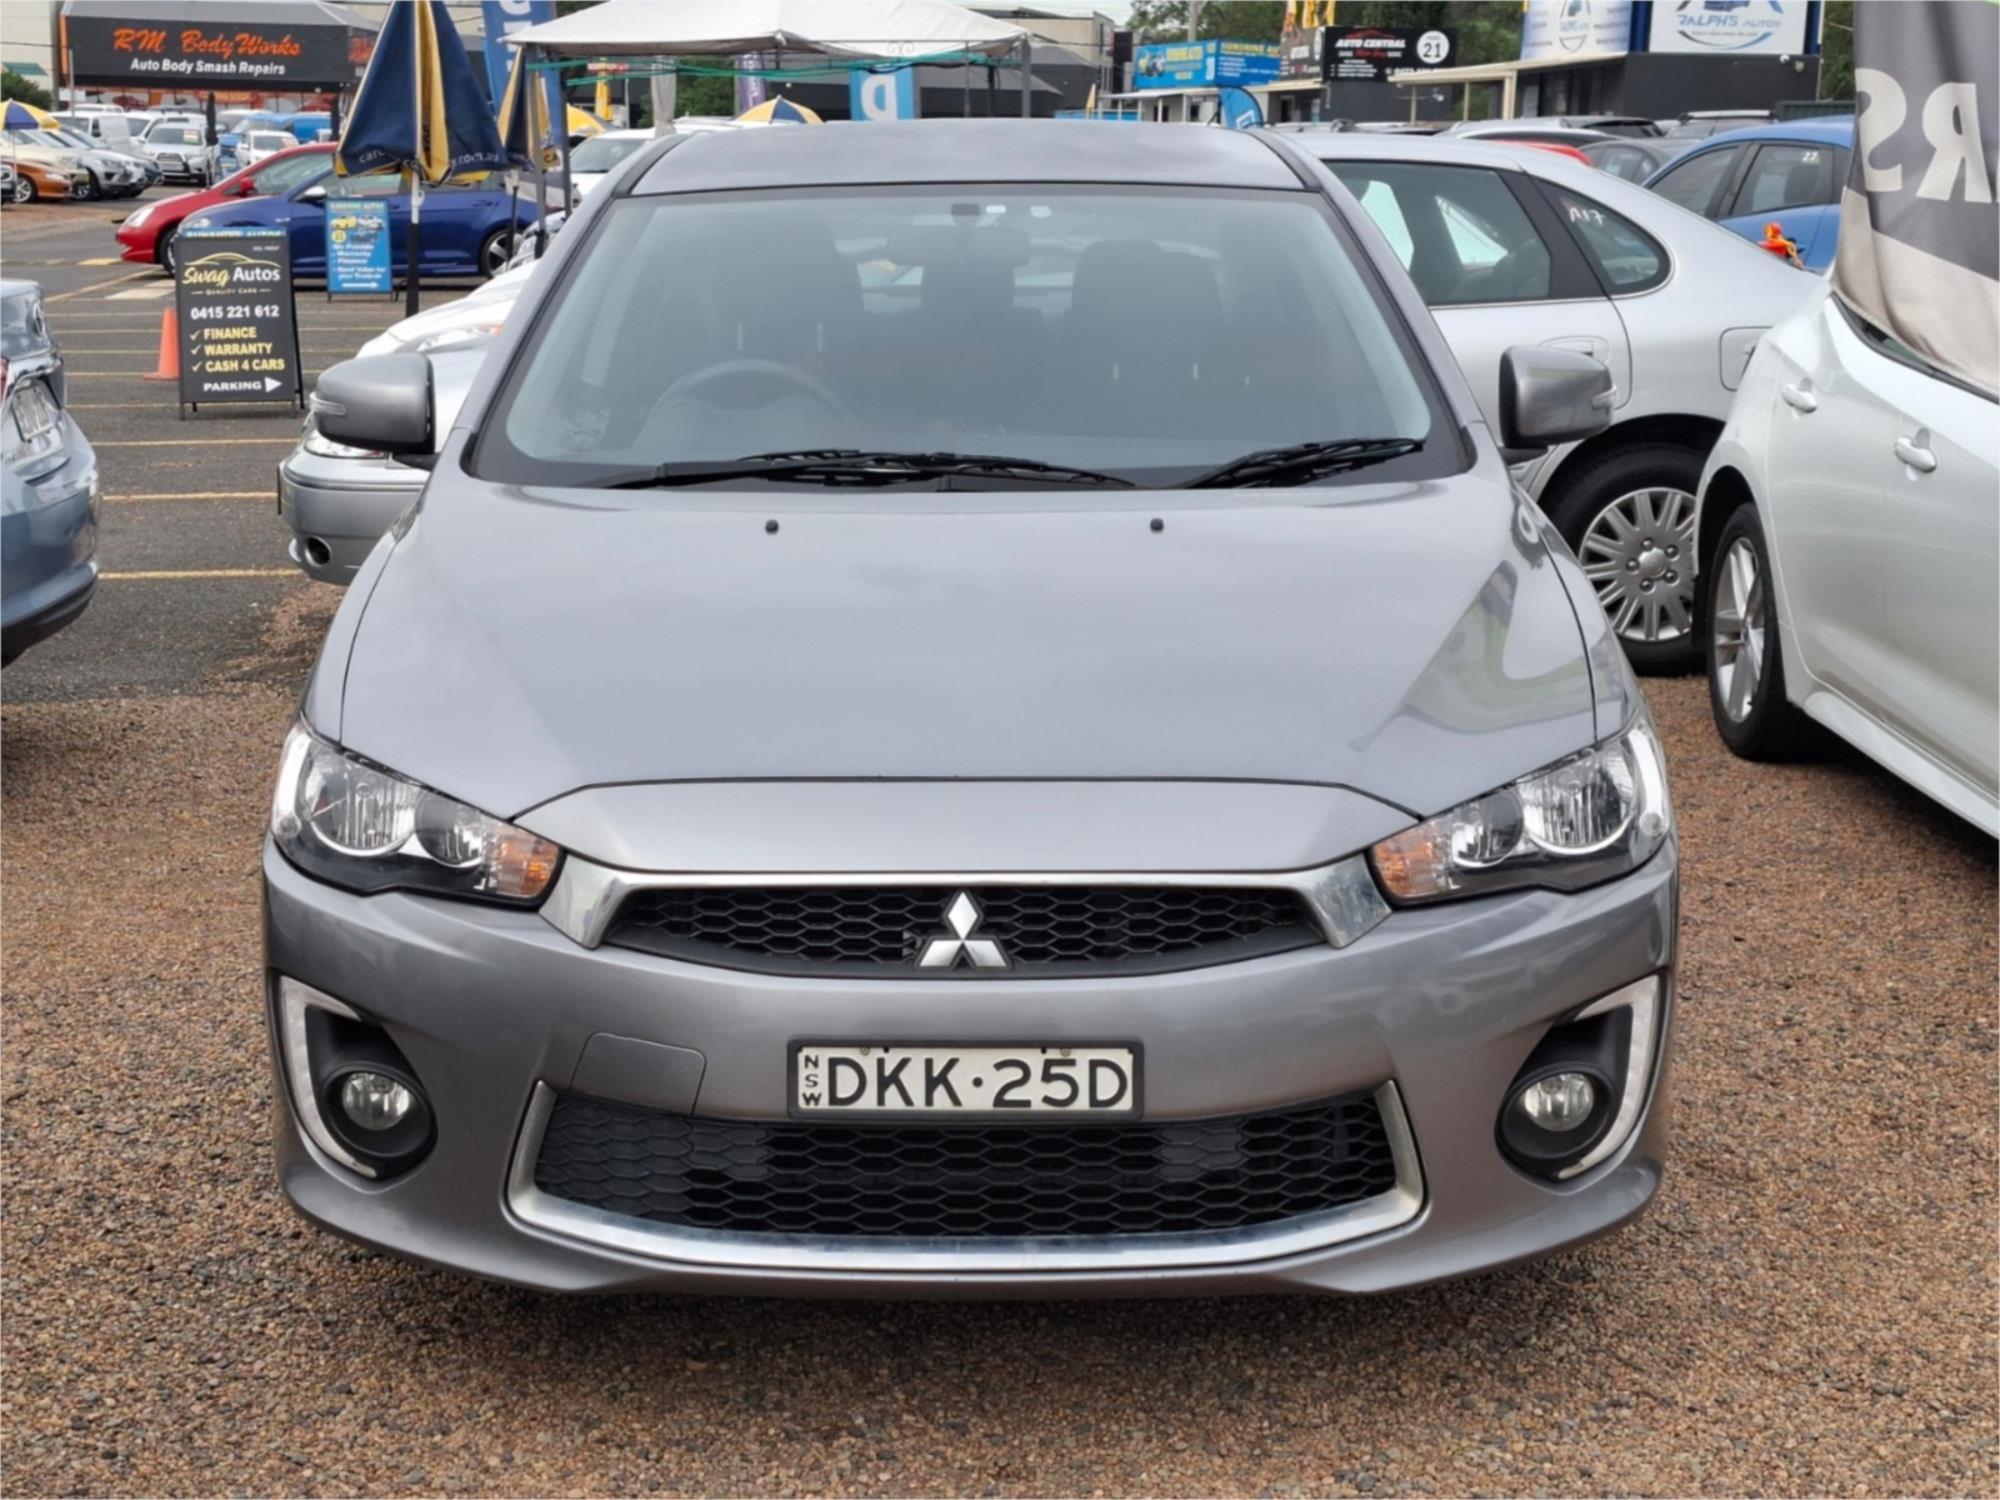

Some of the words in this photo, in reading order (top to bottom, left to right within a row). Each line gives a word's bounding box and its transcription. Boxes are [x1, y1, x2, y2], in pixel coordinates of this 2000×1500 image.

[113, 27, 168, 53] RM
[1335, 38, 1362, 48] AUTO
[1363, 39, 1406, 48] CENTRAL
[1423, 42, 1442, 59] 21
[130, 58, 160, 72] Auto
[162, 59, 194, 75] Body
[196, 60, 236, 74] Smash
[239, 61, 286, 76] Repairs
[182, 266, 230, 287] Swag
[232, 267, 281, 282] Autos
[190, 306, 223, 319] 0415
[226, 305, 250, 318] 221
[254, 304, 280, 317] 612
[203, 327, 257, 340] FINANCE
[203, 342, 273, 356] WARRANTY
[205, 360, 239, 372] CASH
[241, 360, 250, 371] 4
[252, 359, 286, 371] CARS
[203, 381, 262, 392] PARKING
